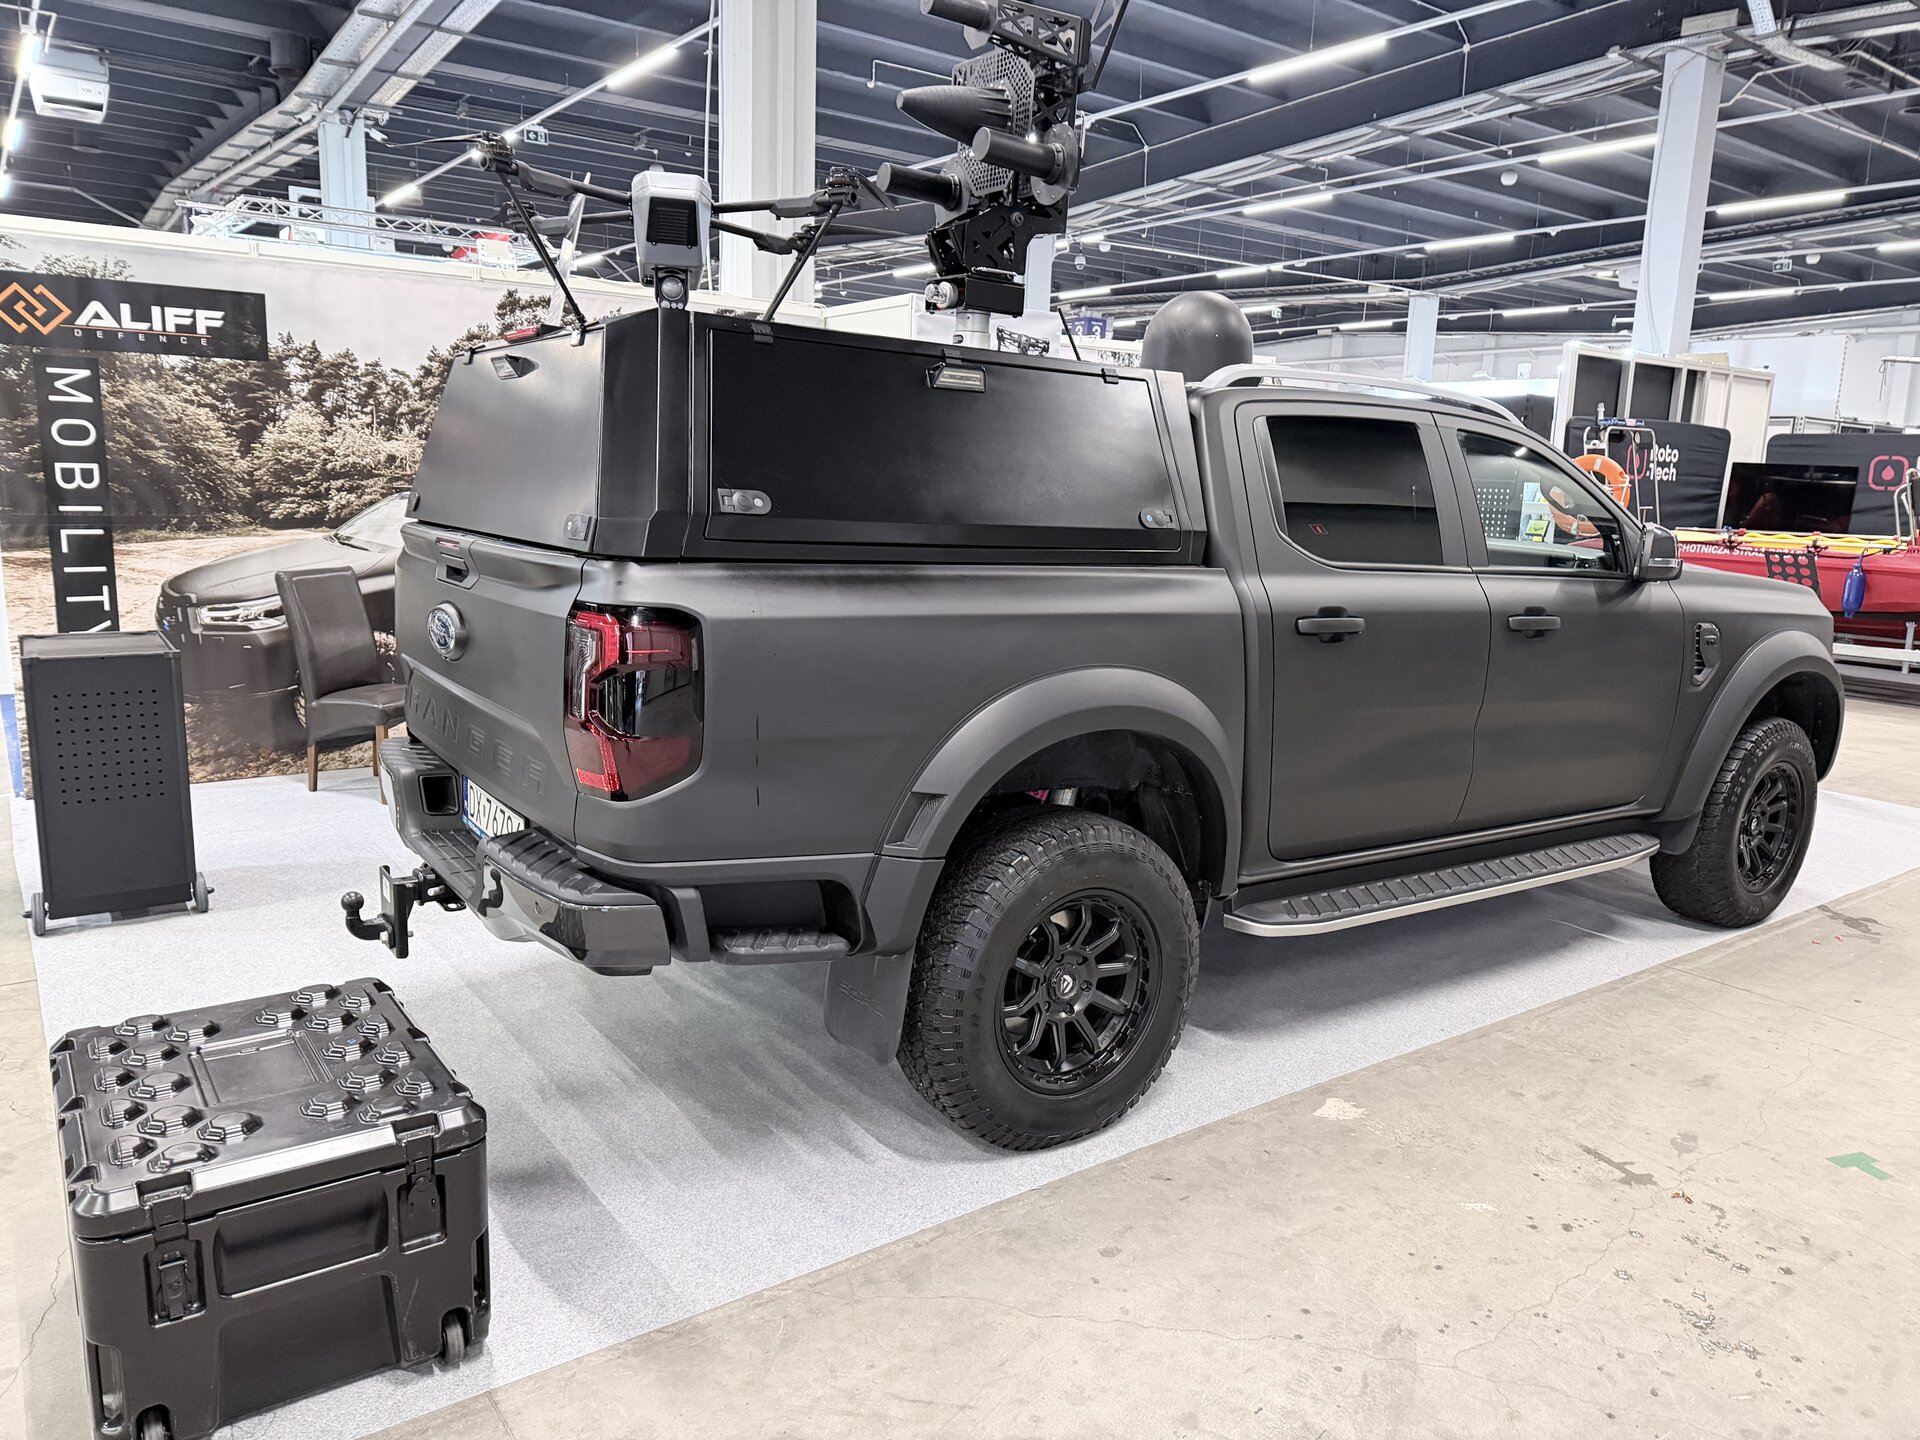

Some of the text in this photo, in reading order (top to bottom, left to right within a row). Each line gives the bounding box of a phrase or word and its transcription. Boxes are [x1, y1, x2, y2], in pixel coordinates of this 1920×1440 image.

[74, 300, 225, 334] ALIFF
[74, 329, 208, 346] DEFENCE
[1677, 543, 1730, 555] CHOTNICZA
